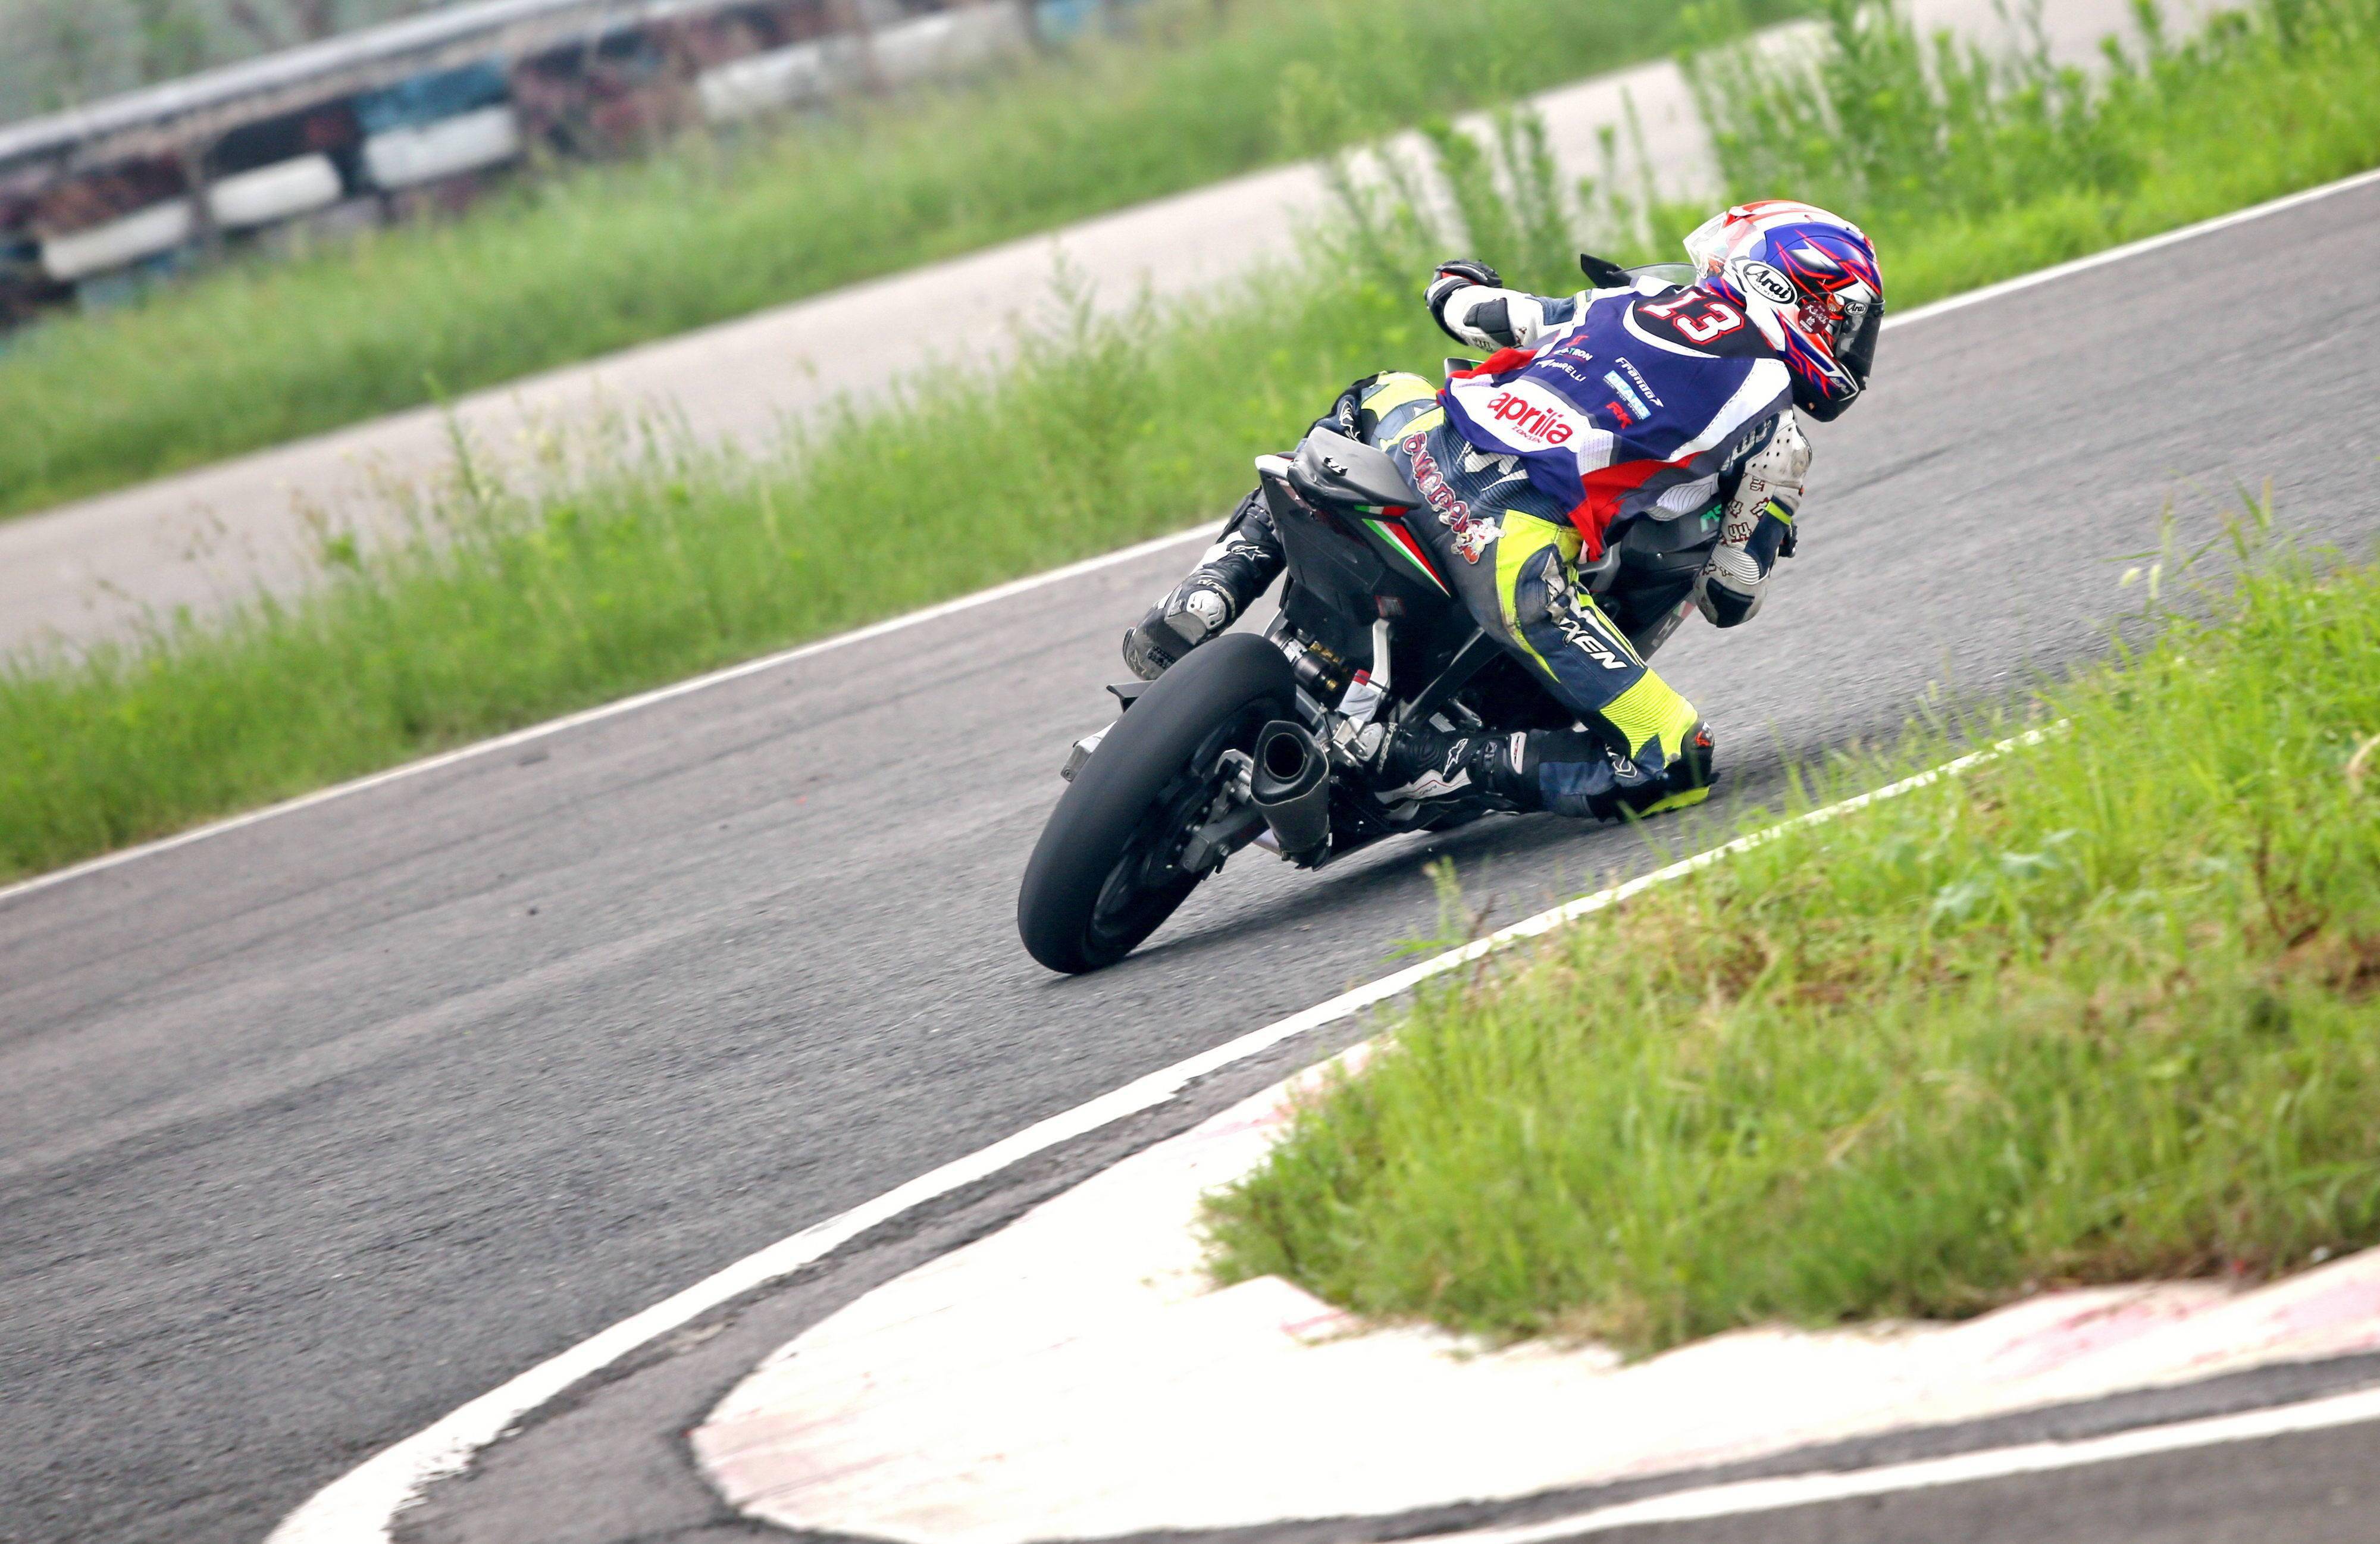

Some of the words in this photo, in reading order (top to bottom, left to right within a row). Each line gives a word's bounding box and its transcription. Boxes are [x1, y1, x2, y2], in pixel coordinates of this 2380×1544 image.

[1745, 269, 1792, 299] Arai
[1637, 286, 1745, 345] 13
[1847, 303, 1865, 312] Arai
[1615, 357, 1656, 400] Frando
[1488, 392, 1573, 444] aprilia
[1605, 402, 1633, 429] RK
